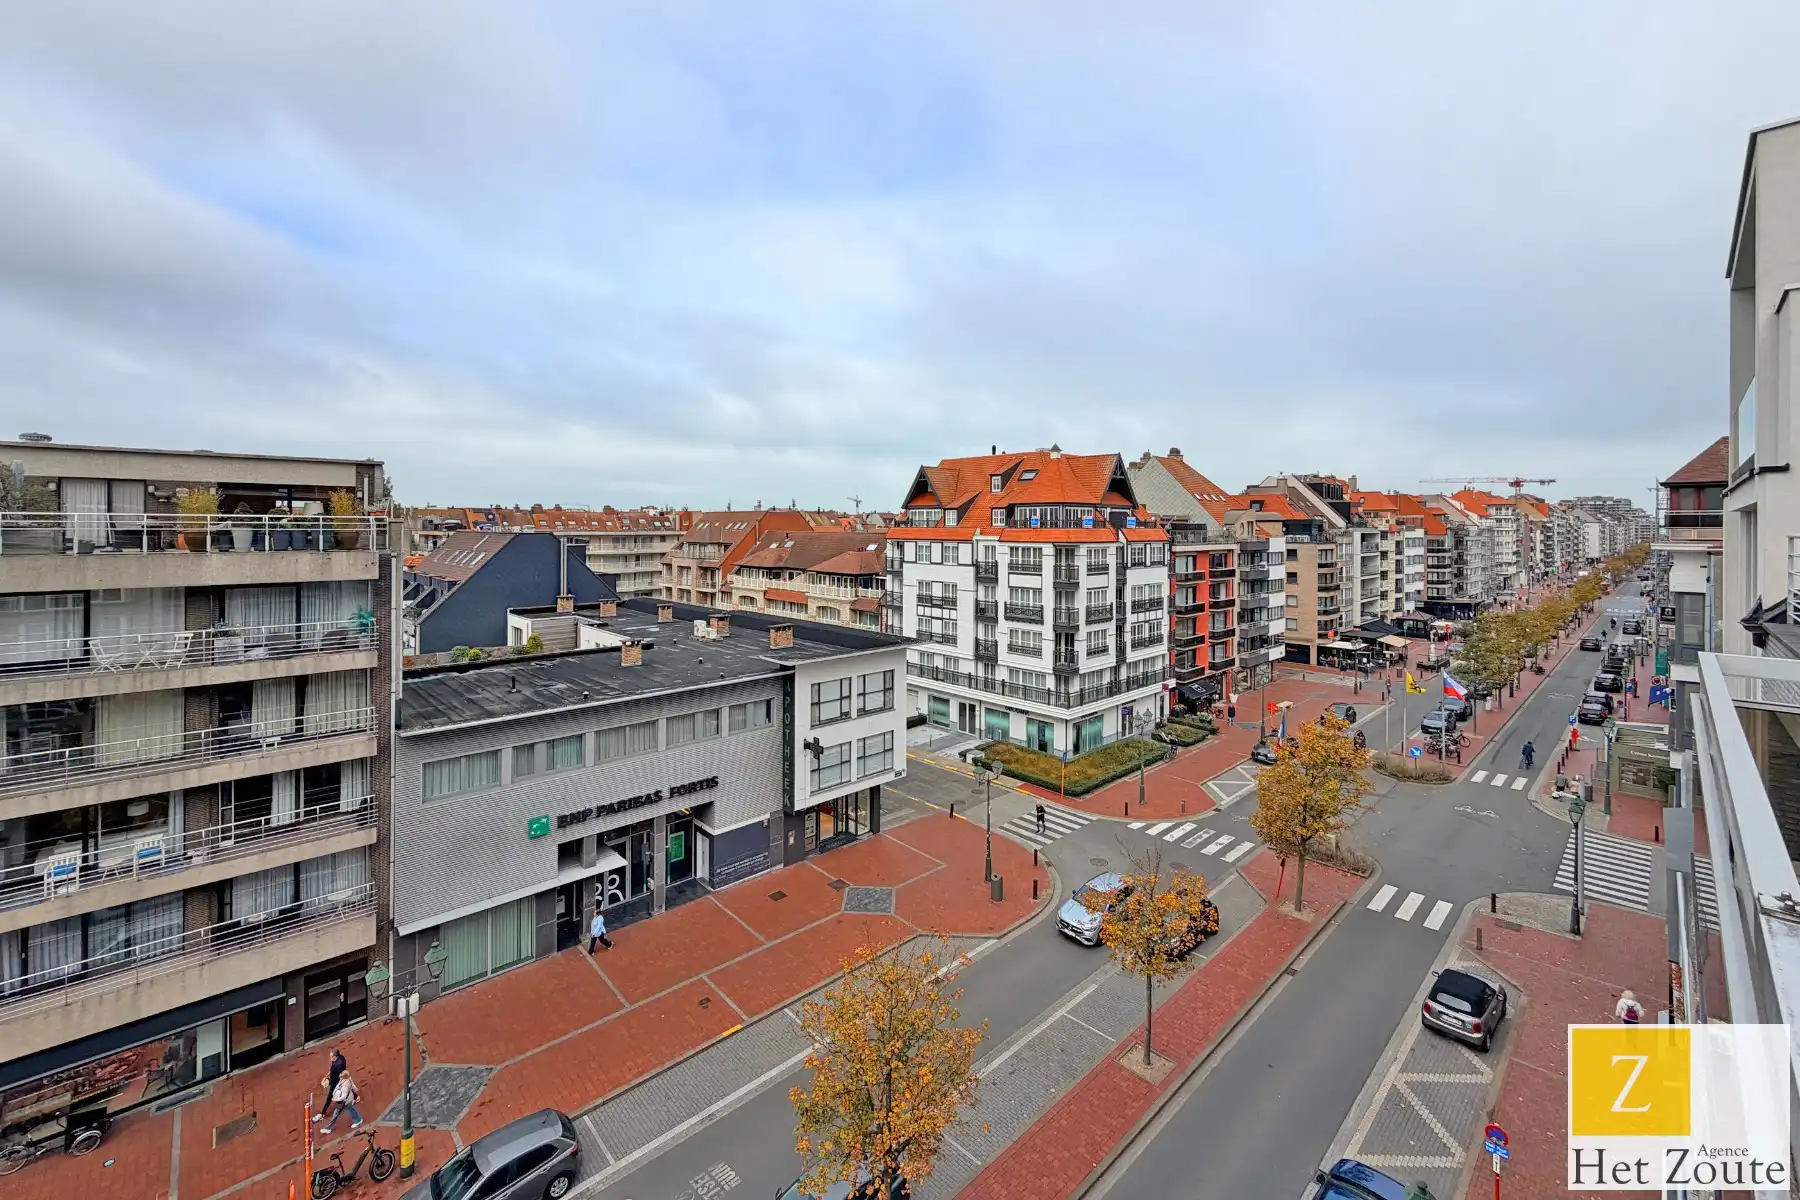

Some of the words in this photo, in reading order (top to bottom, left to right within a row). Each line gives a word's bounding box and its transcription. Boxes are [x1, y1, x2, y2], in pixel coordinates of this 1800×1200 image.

[557, 808, 593, 828] BNP
[597, 790, 662, 817] PARIBAS
[669, 776, 719, 798] FORTIS
